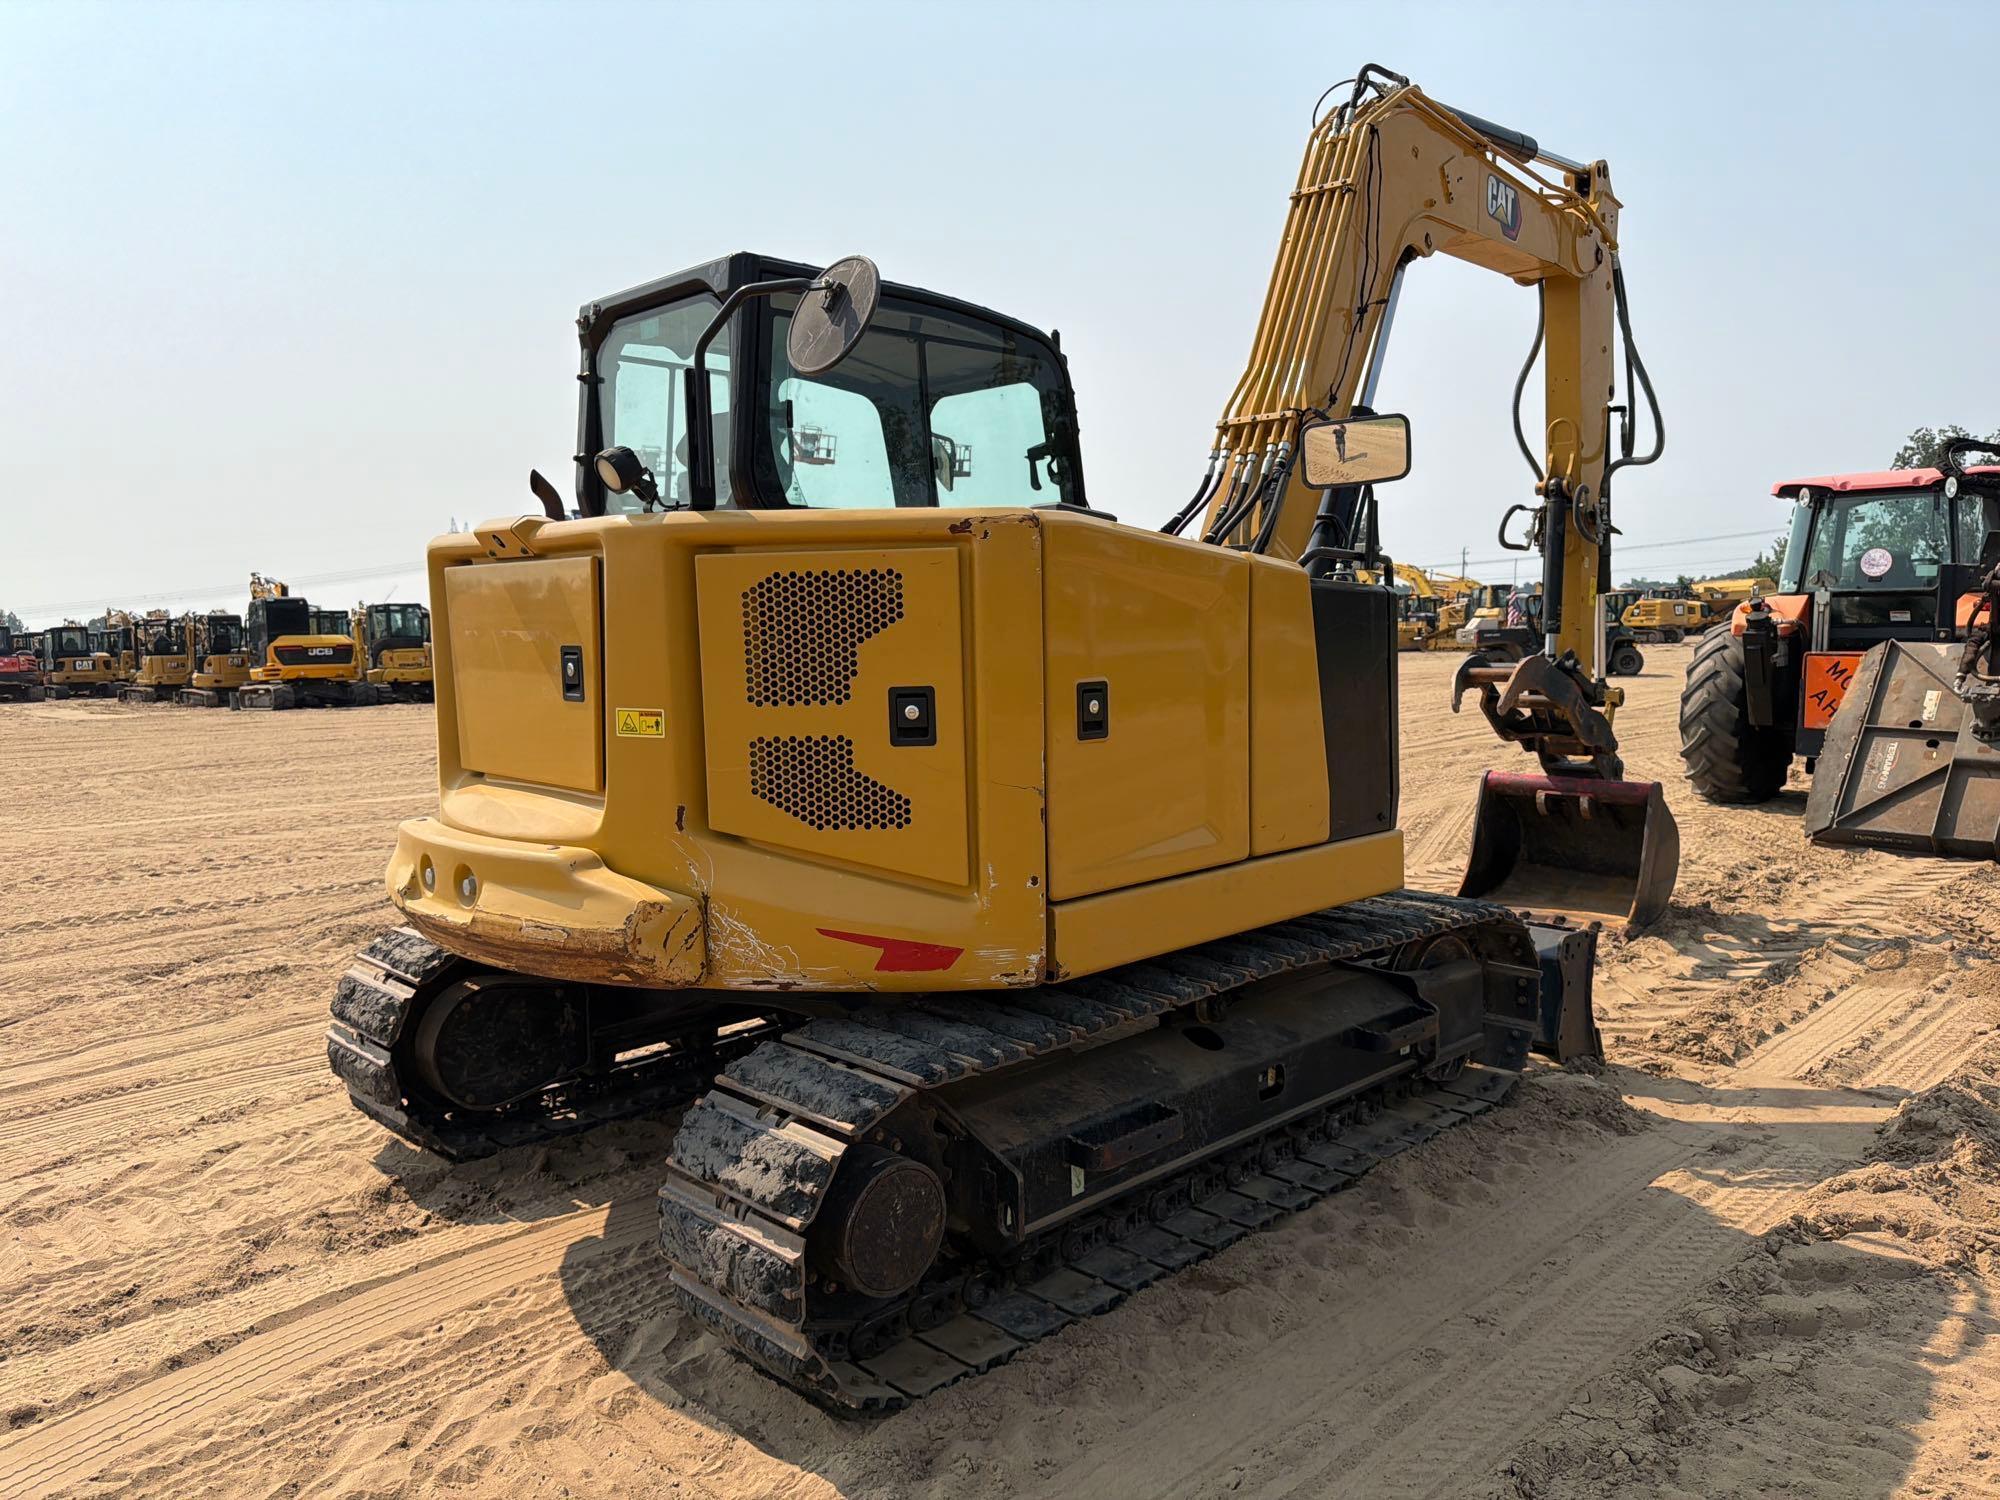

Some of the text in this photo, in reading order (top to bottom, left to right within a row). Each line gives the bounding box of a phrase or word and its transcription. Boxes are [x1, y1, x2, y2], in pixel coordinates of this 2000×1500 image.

[1488, 175, 1515, 226] CAT
[308, 648, 333, 656] JCB
[76, 660, 93, 671] CAT
